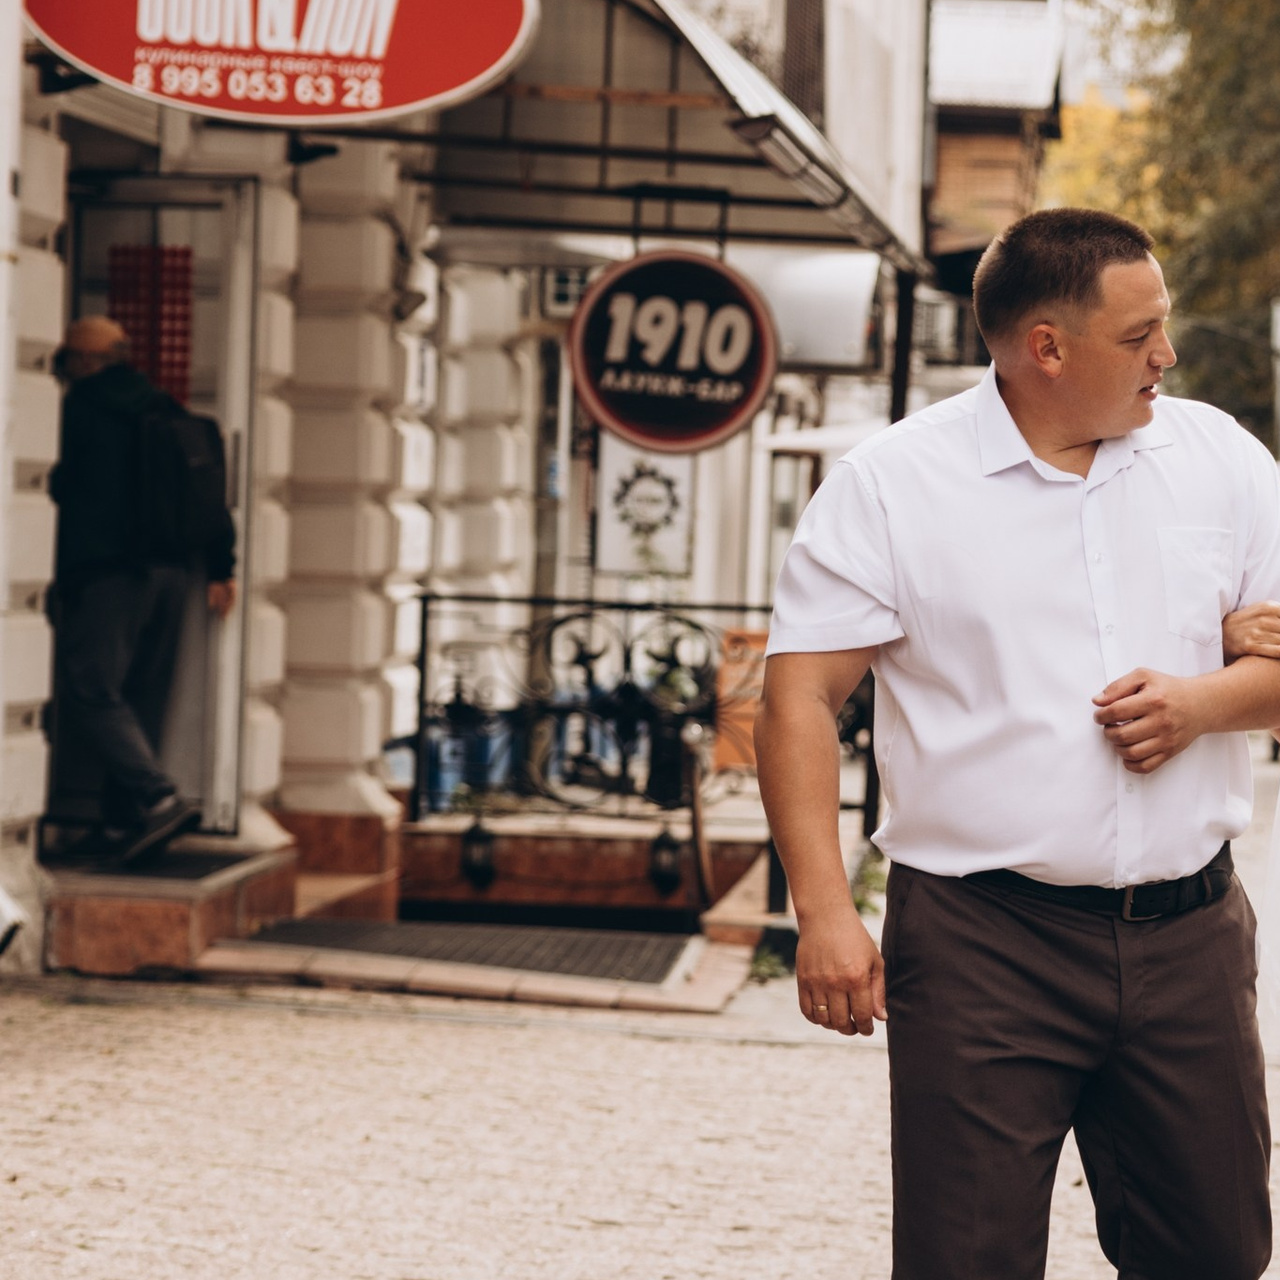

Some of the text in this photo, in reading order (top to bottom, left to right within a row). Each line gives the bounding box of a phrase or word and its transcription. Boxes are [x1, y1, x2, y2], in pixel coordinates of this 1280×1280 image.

[132, 62, 382, 109] 8 995 053 63 28
[604, 293, 753, 375] 1910
